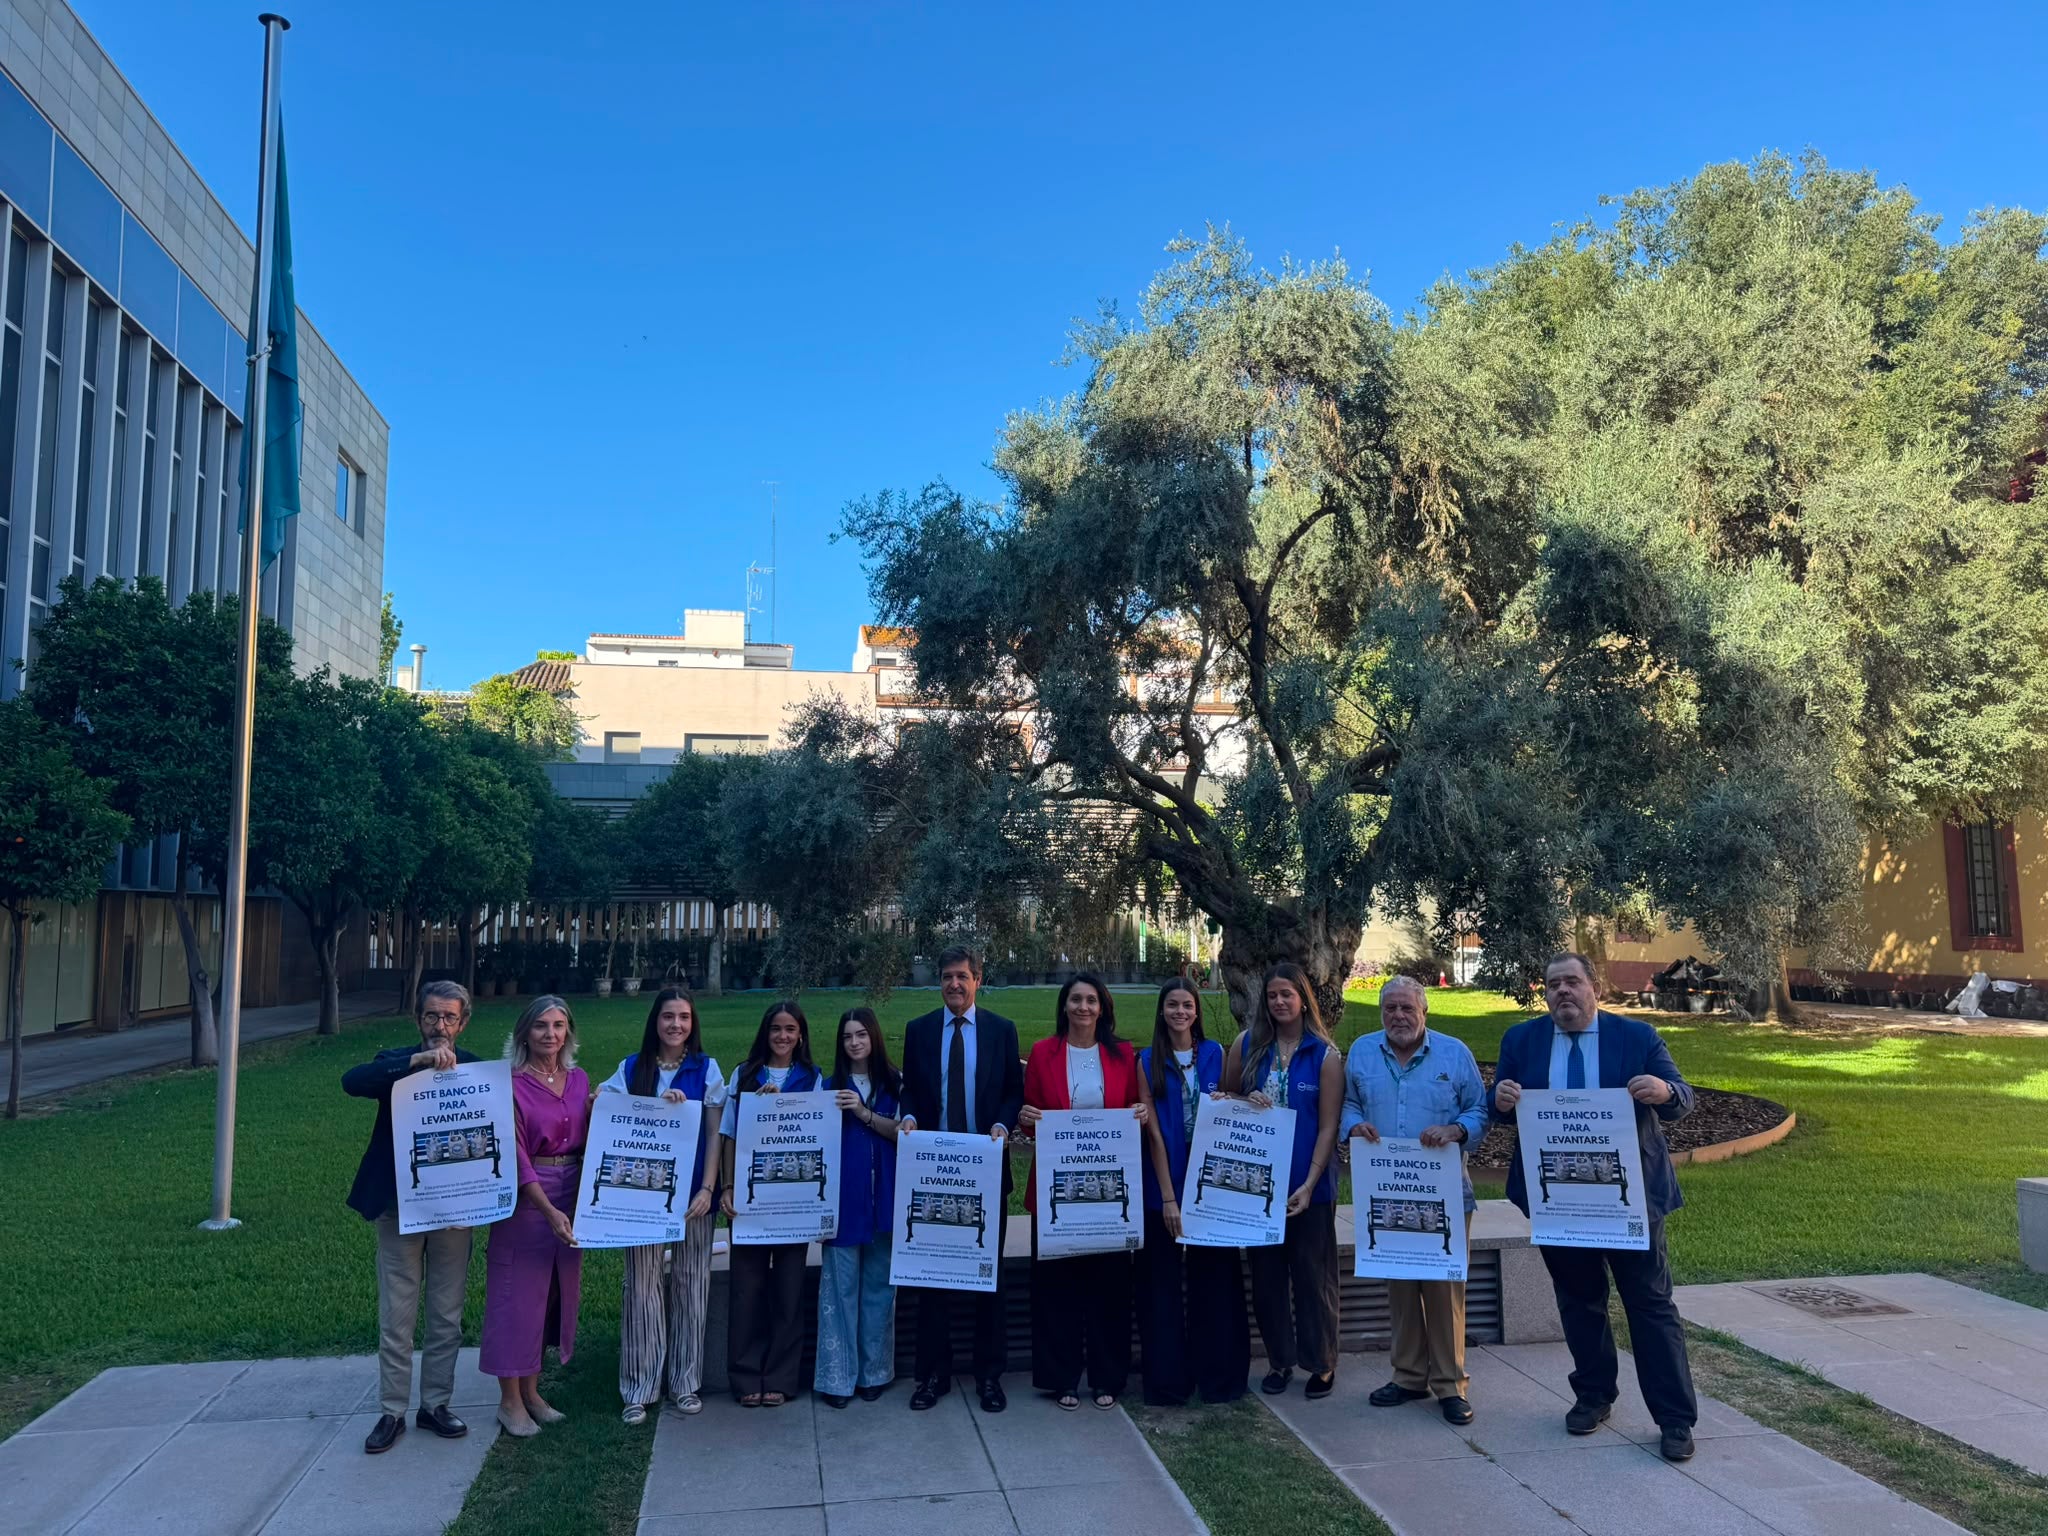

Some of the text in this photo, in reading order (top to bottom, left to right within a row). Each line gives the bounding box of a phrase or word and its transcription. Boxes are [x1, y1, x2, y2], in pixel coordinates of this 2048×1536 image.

[414, 1090, 436, 1101] ESTE
[439, 1086, 476, 1097] BANCO
[439, 1101, 467, 1110] PARA
[422, 1110, 486, 1125] LEVANTARSE
[779, 1112, 810, 1121] BANCO
[1538, 1111, 1560, 1119] ESTE
[611, 1115, 632, 1124] ESTE
[634, 1118, 667, 1127] BANCO
[1213, 1117, 1275, 1135] ESTE BANCO ES
[632, 1129, 656, 1139] PARA
[1230, 1132, 1253, 1143] PARA
[761, 1136, 817, 1144] LEVANTARSE
[1547, 1136, 1610, 1144] LEVANTARSE
[613, 1140, 671, 1152] LEVANTARSE
[1214, 1141, 1268, 1158] LEVANTARSE
[916, 1152, 982, 1164] ESTE BANCO ES
[1061, 1155, 1117, 1164] LEVANTARSE
[1371, 1159, 1391, 1167] ESTE
[1394, 1160, 1427, 1169] BANCO
[937, 1166, 960, 1174] PARA
[1394, 1172, 1419, 1181] PARA
[920, 1177, 976, 1188] LEVANTARSE
[1378, 1183, 1437, 1193] LEVANTARSE
